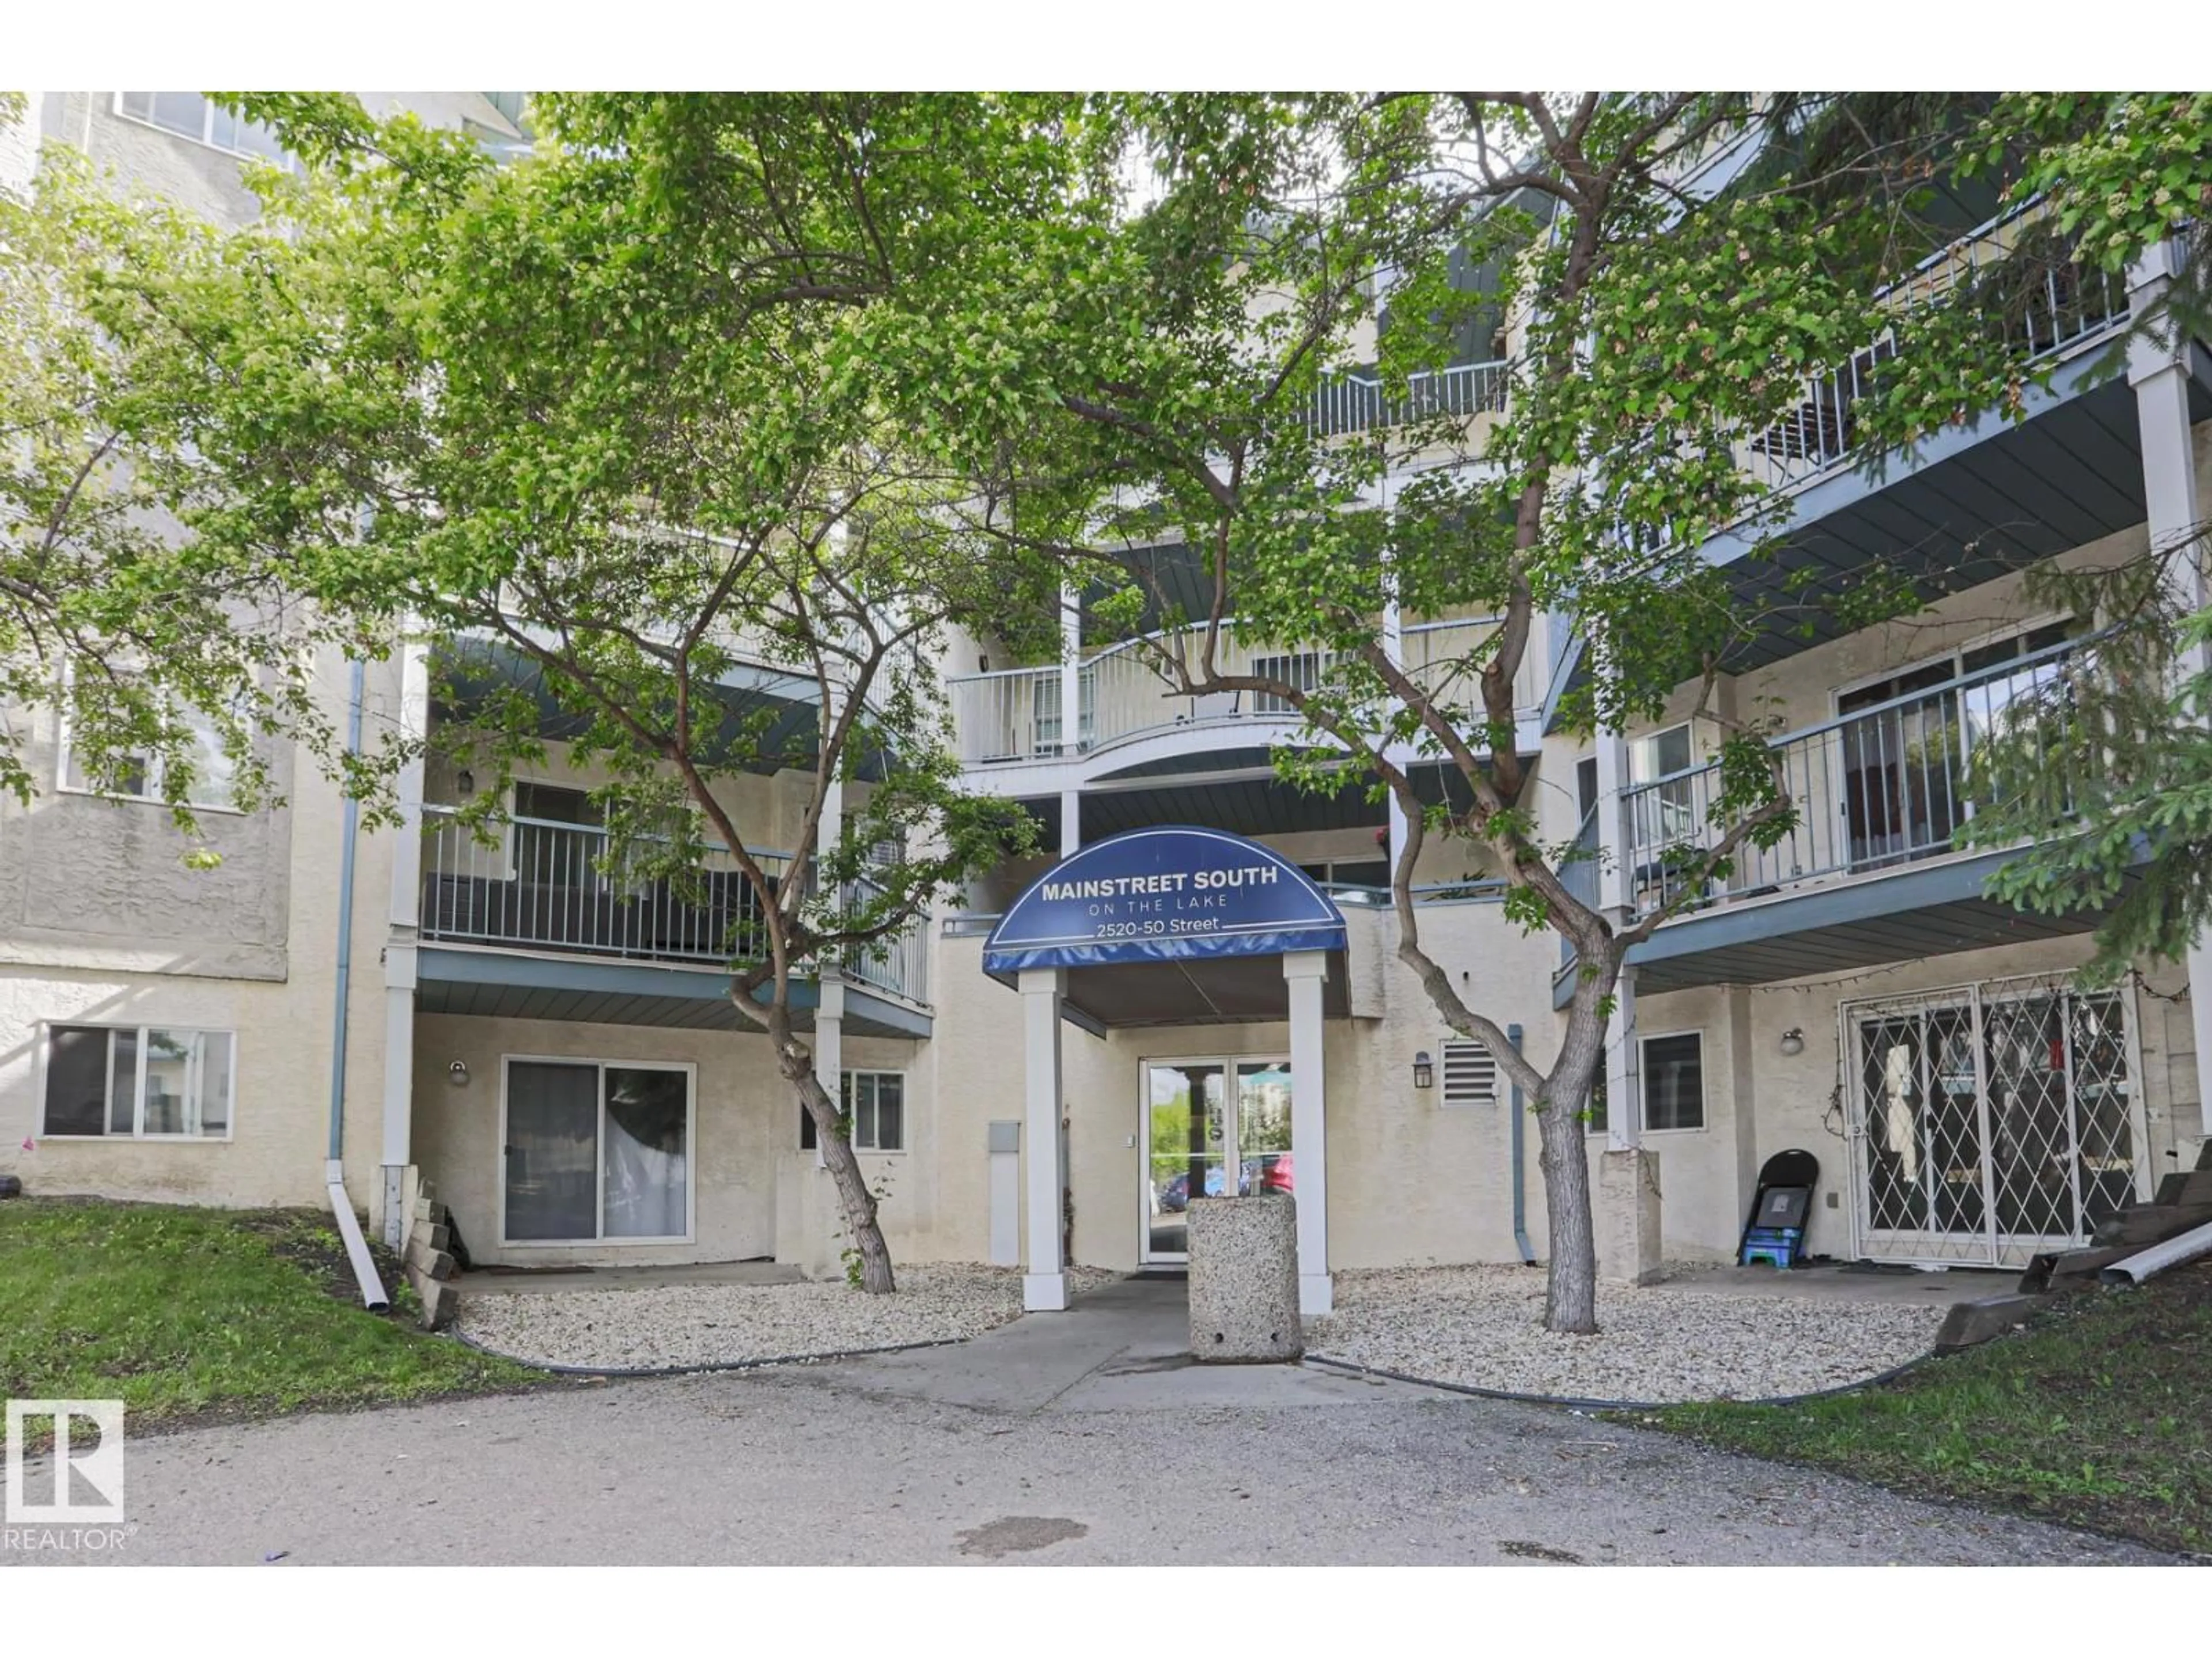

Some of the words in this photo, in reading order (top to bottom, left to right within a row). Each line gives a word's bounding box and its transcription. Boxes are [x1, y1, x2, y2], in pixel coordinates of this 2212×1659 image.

[1043, 873, 1188, 901] MAINSTREET
[1194, 866, 1277, 889] SOUTH
[1089, 904, 1113, 916] ON
[1128, 899, 1162, 913] THE
[1177, 895, 1227, 910] LAKE
[1097, 921, 1165, 938] 2520-50
[1170, 917, 1219, 932] Street
